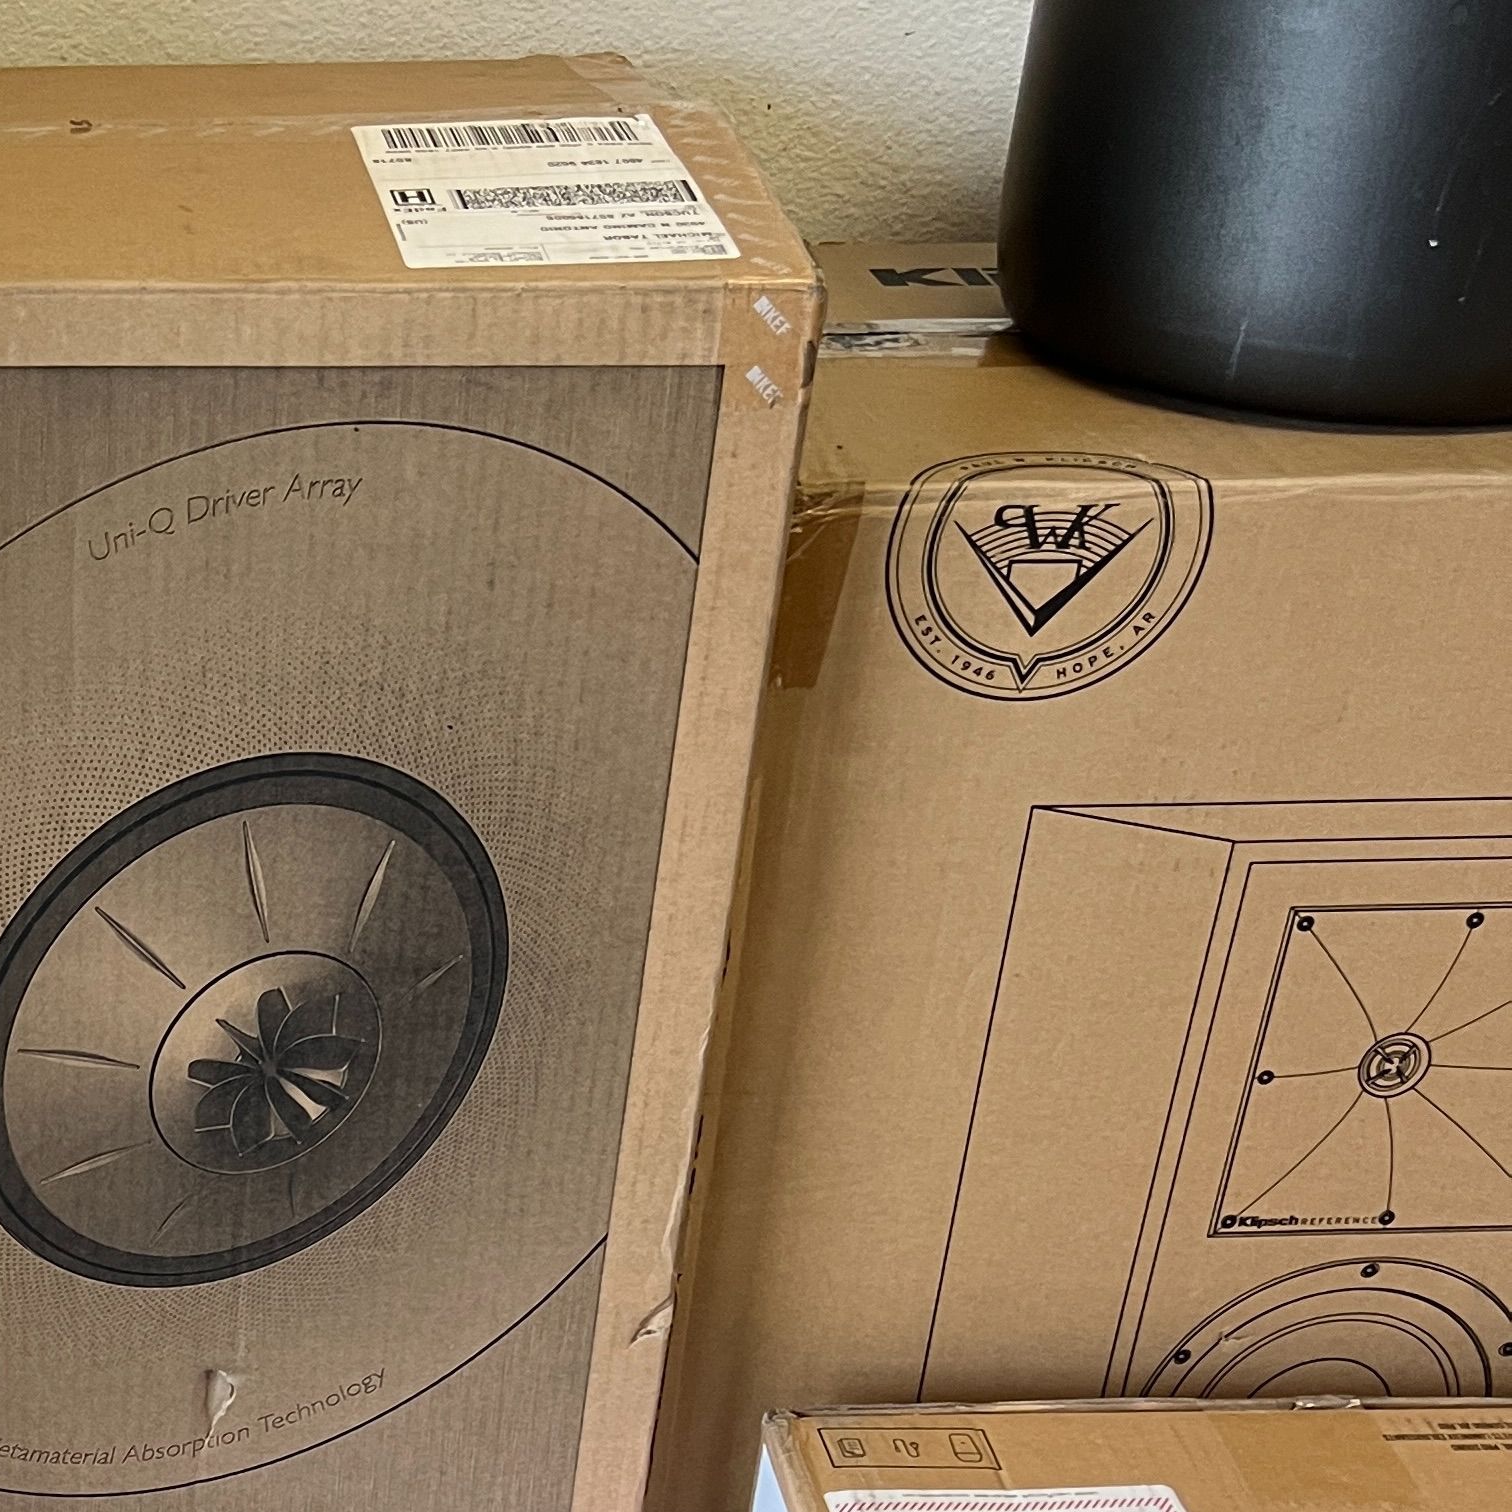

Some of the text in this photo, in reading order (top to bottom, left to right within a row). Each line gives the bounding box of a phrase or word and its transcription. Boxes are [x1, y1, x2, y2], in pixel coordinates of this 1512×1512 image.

[88, 472, 364, 562] Uni-Q Driver Array
[1132, 610, 1157, 637] AR
[950, 653, 997, 682] 1946
[121, 1426, 251, 1467] Absorption
[257, 1367, 388, 1434] Technology
